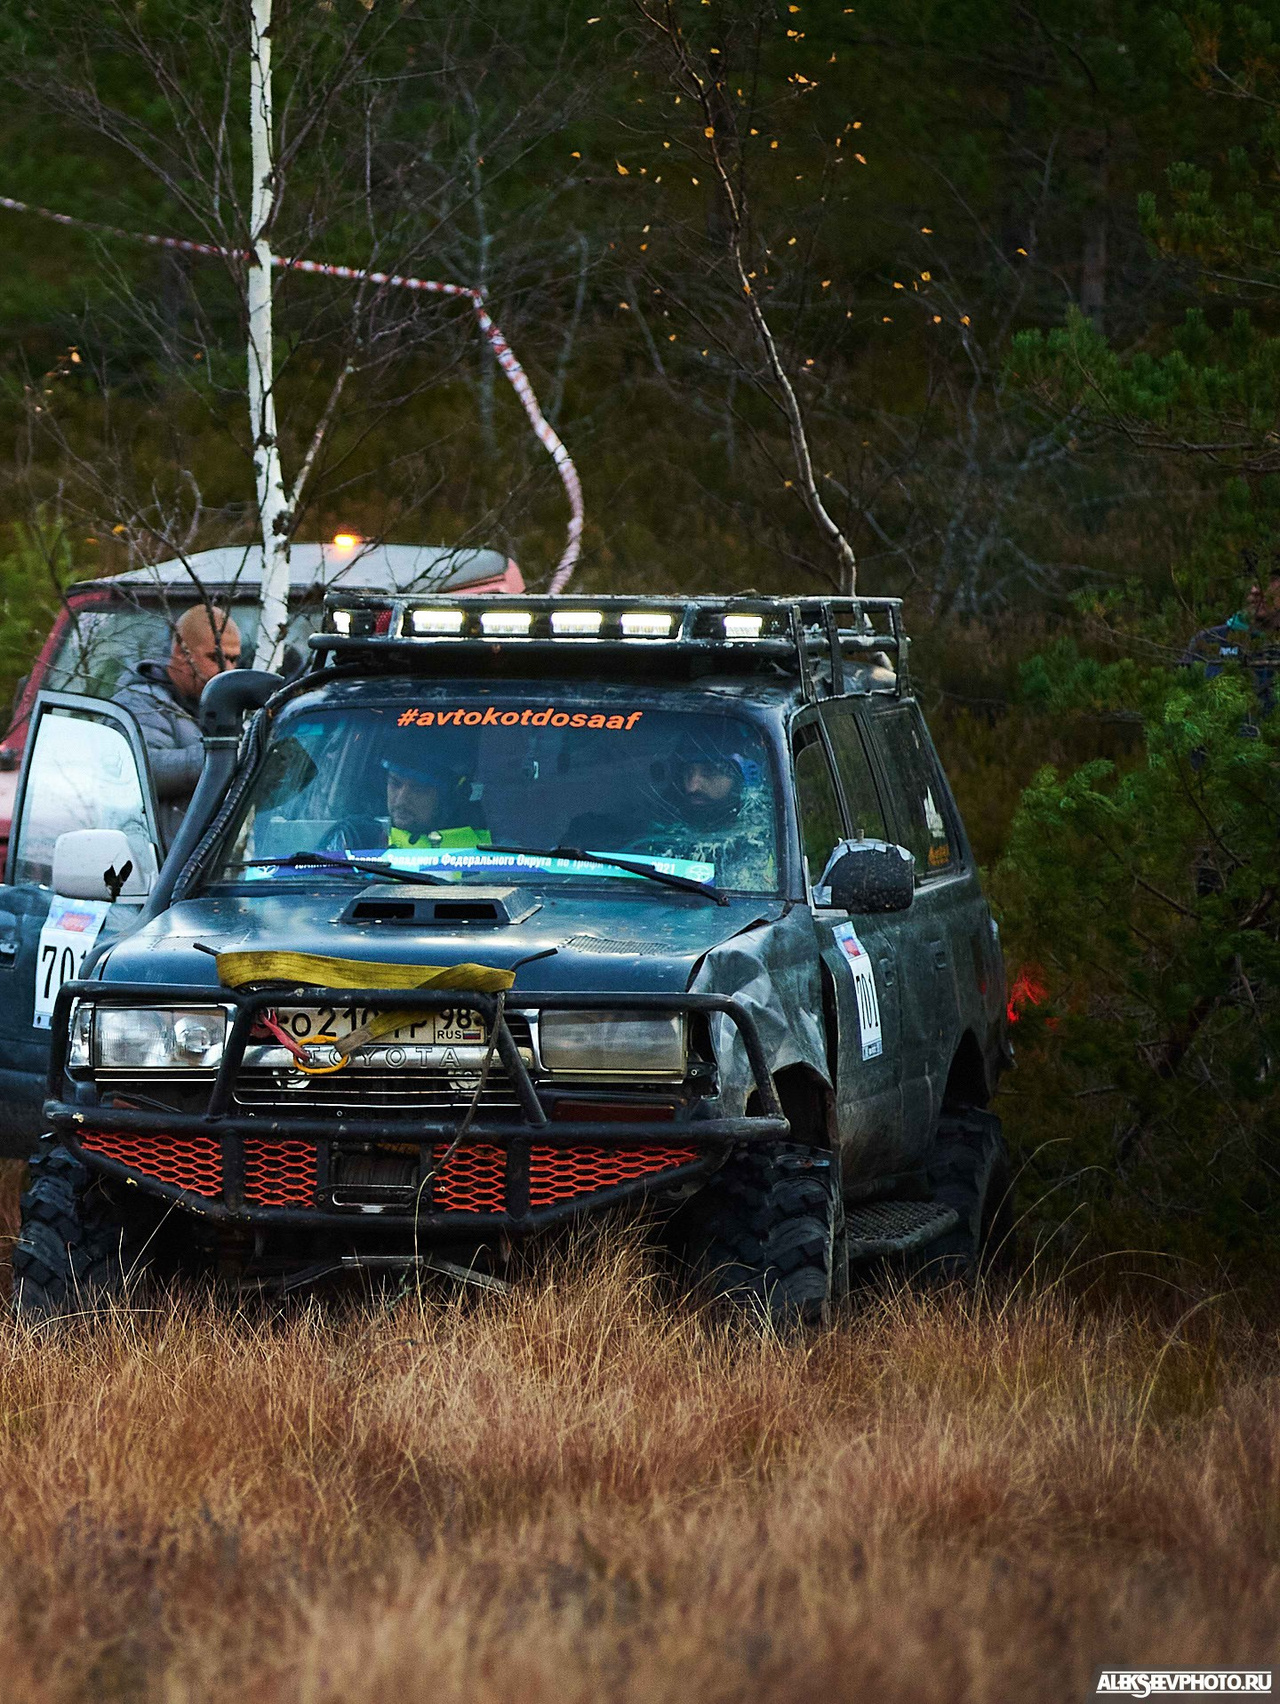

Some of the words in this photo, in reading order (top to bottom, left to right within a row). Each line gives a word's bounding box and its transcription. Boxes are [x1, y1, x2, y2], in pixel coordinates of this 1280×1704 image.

[397, 707, 643, 730] #avtokotdosaaf
[441, 853, 514, 867] Федерального
[517, 854, 551, 868] Округа
[42, 946, 87, 999] 70
[437, 1029, 462, 1040] RUS
